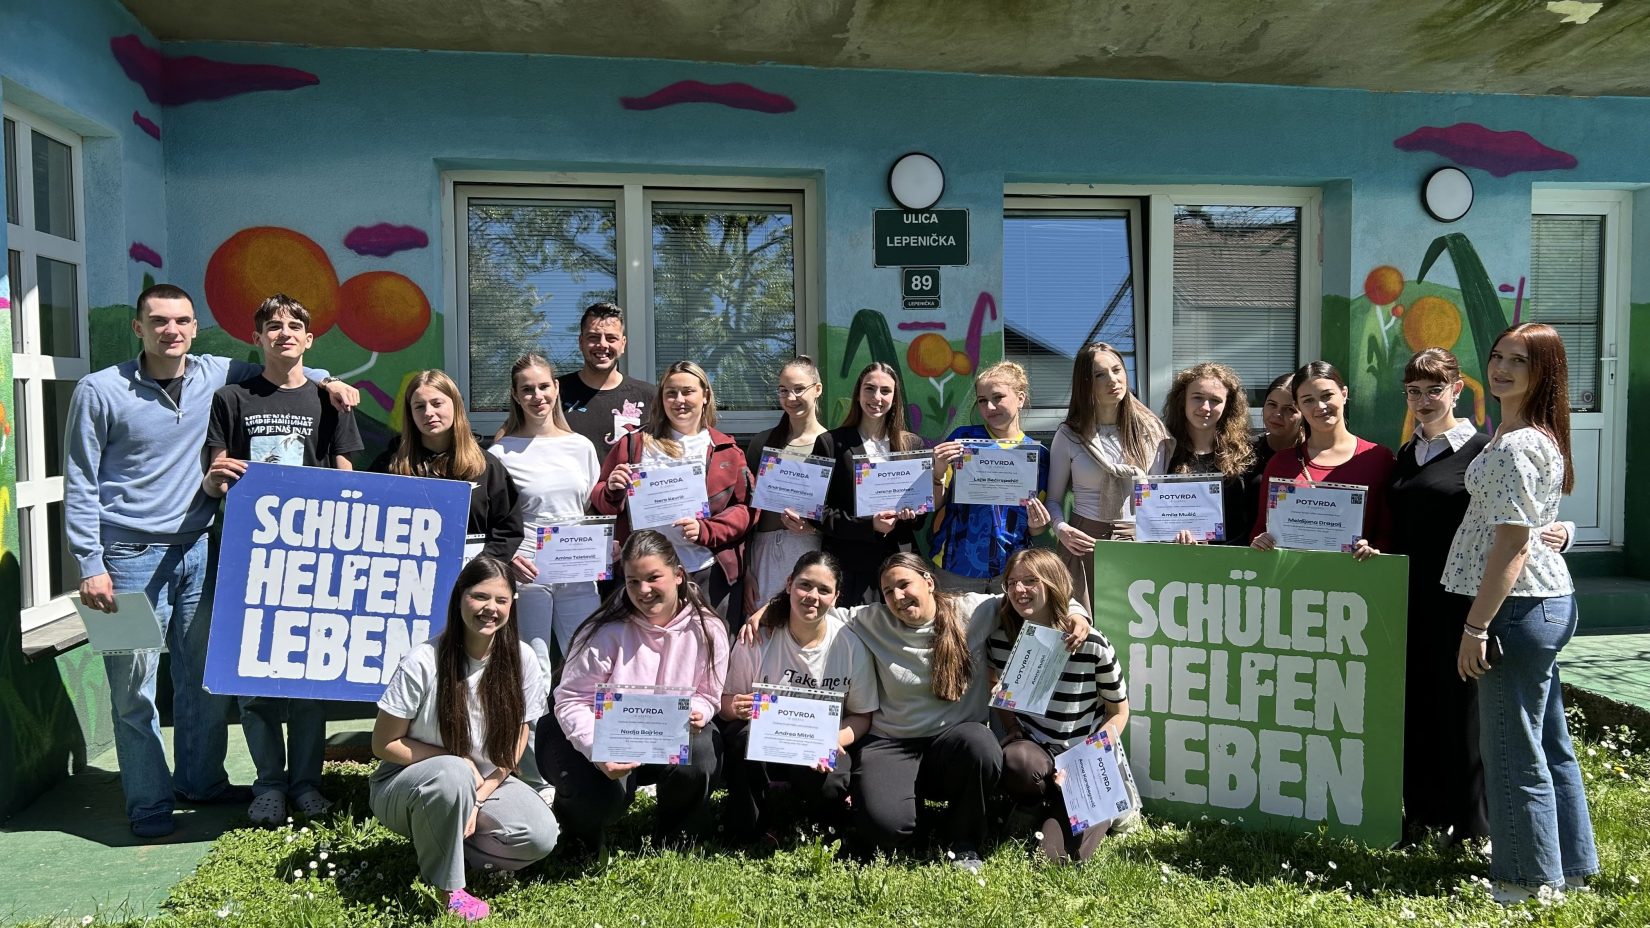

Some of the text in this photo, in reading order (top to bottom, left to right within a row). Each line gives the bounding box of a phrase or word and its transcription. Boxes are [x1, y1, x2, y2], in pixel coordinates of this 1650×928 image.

[903, 214, 938, 224] ULICA
[886, 233, 956, 246] LEPENIČKA
[911, 275, 932, 291] 89
[650, 477, 684, 487] POTVRDA
[780, 469, 810, 479] POTVRDA
[878, 470, 910, 478] POTVRDA
[1296, 499, 1336, 507] POTVRDA
[252, 490, 442, 557] SCHÜLER
[244, 548, 437, 616] HELFEN
[1127, 569, 1368, 656] SCHÜLER
[238, 608, 431, 686] LEBEN
[1014, 648, 1032, 685] POTVRDA
[784, 669, 817, 689] Take
[821, 678, 840, 690] me
[1128, 642, 1366, 734] HELFEN
[622, 707, 664, 715] POTVRDA
[778, 710, 816, 719] POTVRDA
[1097, 757, 1112, 792] POTVRDA
[1129, 714, 1365, 826] LEBEN
